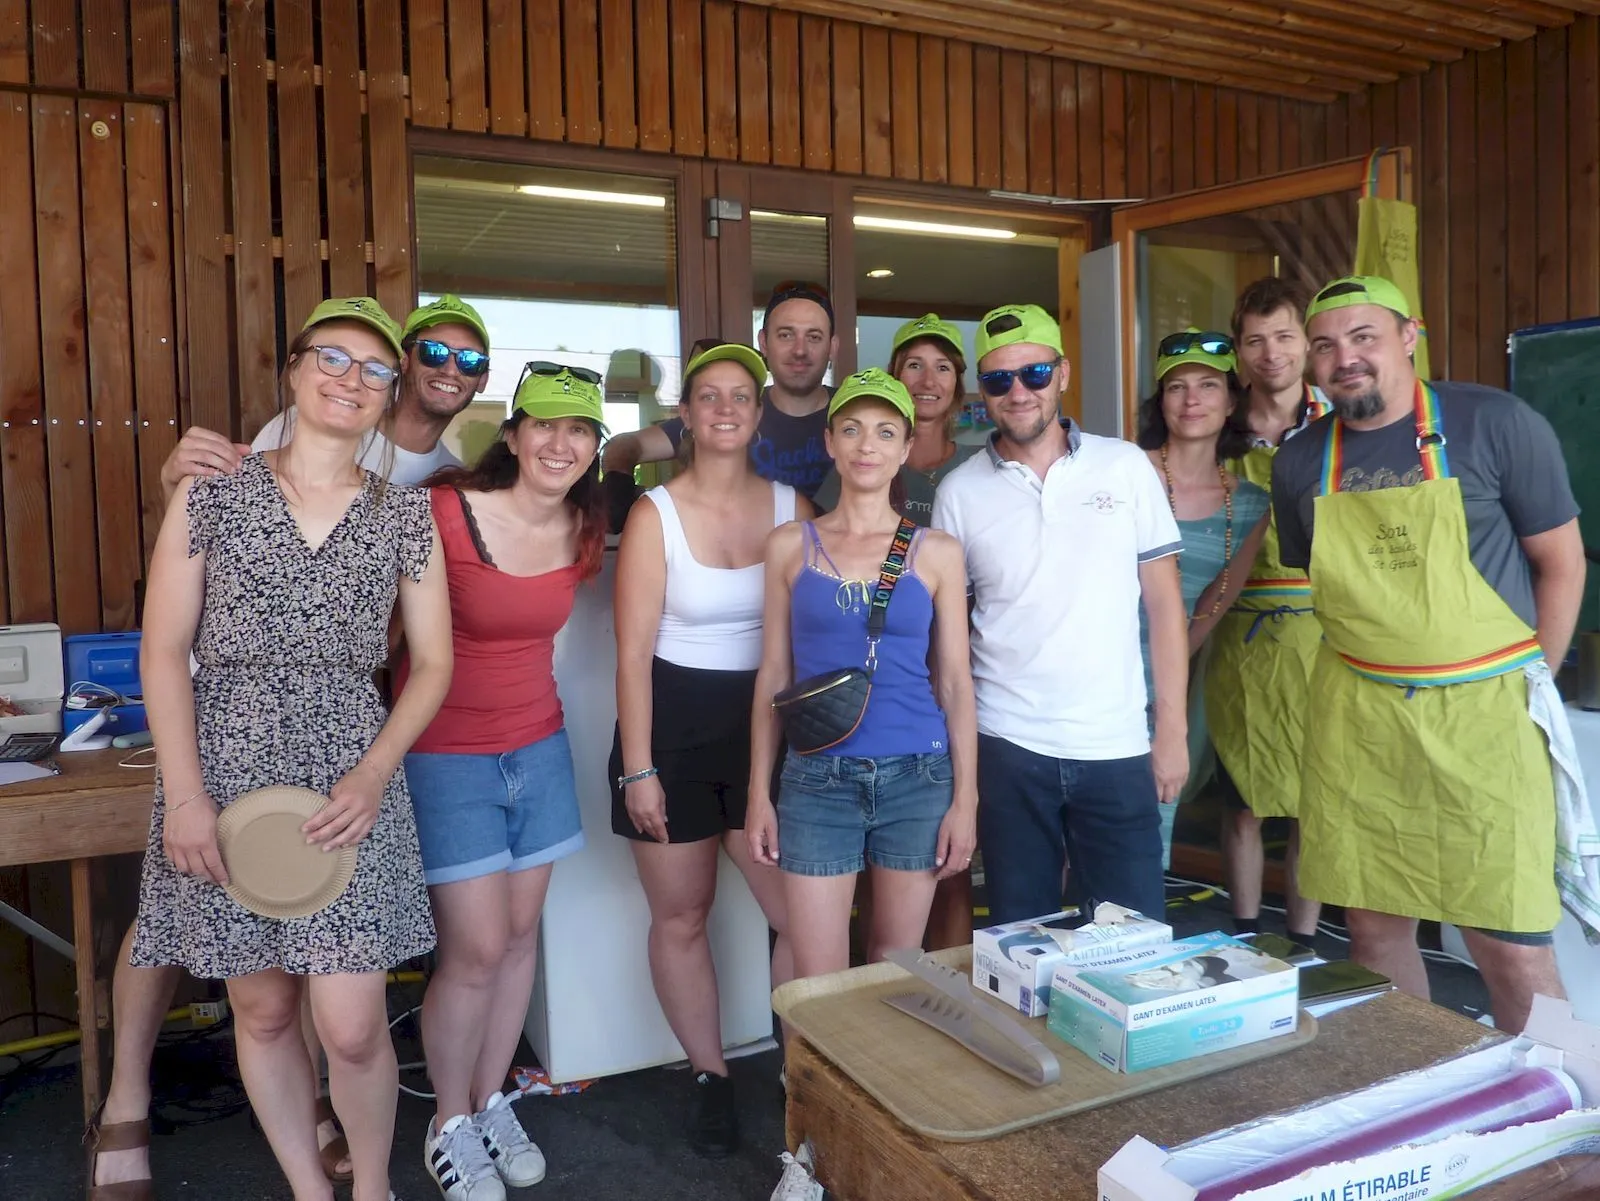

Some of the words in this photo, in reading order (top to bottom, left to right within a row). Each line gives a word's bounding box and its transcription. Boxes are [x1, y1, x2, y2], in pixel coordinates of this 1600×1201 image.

[1376, 523, 1408, 540] Sou
[872, 574, 898, 608] LOVE
[1133, 949, 1158, 960] LATEX
[1091, 995, 1107, 1008] LATEX
[1133, 1010, 1154, 1021] GANT
[1155, 1001, 1194, 1017] D'EXAMEN
[1195, 996, 1218, 1007] LATEX
[1343, 1165, 1432, 1201] ÉTIRABLE
